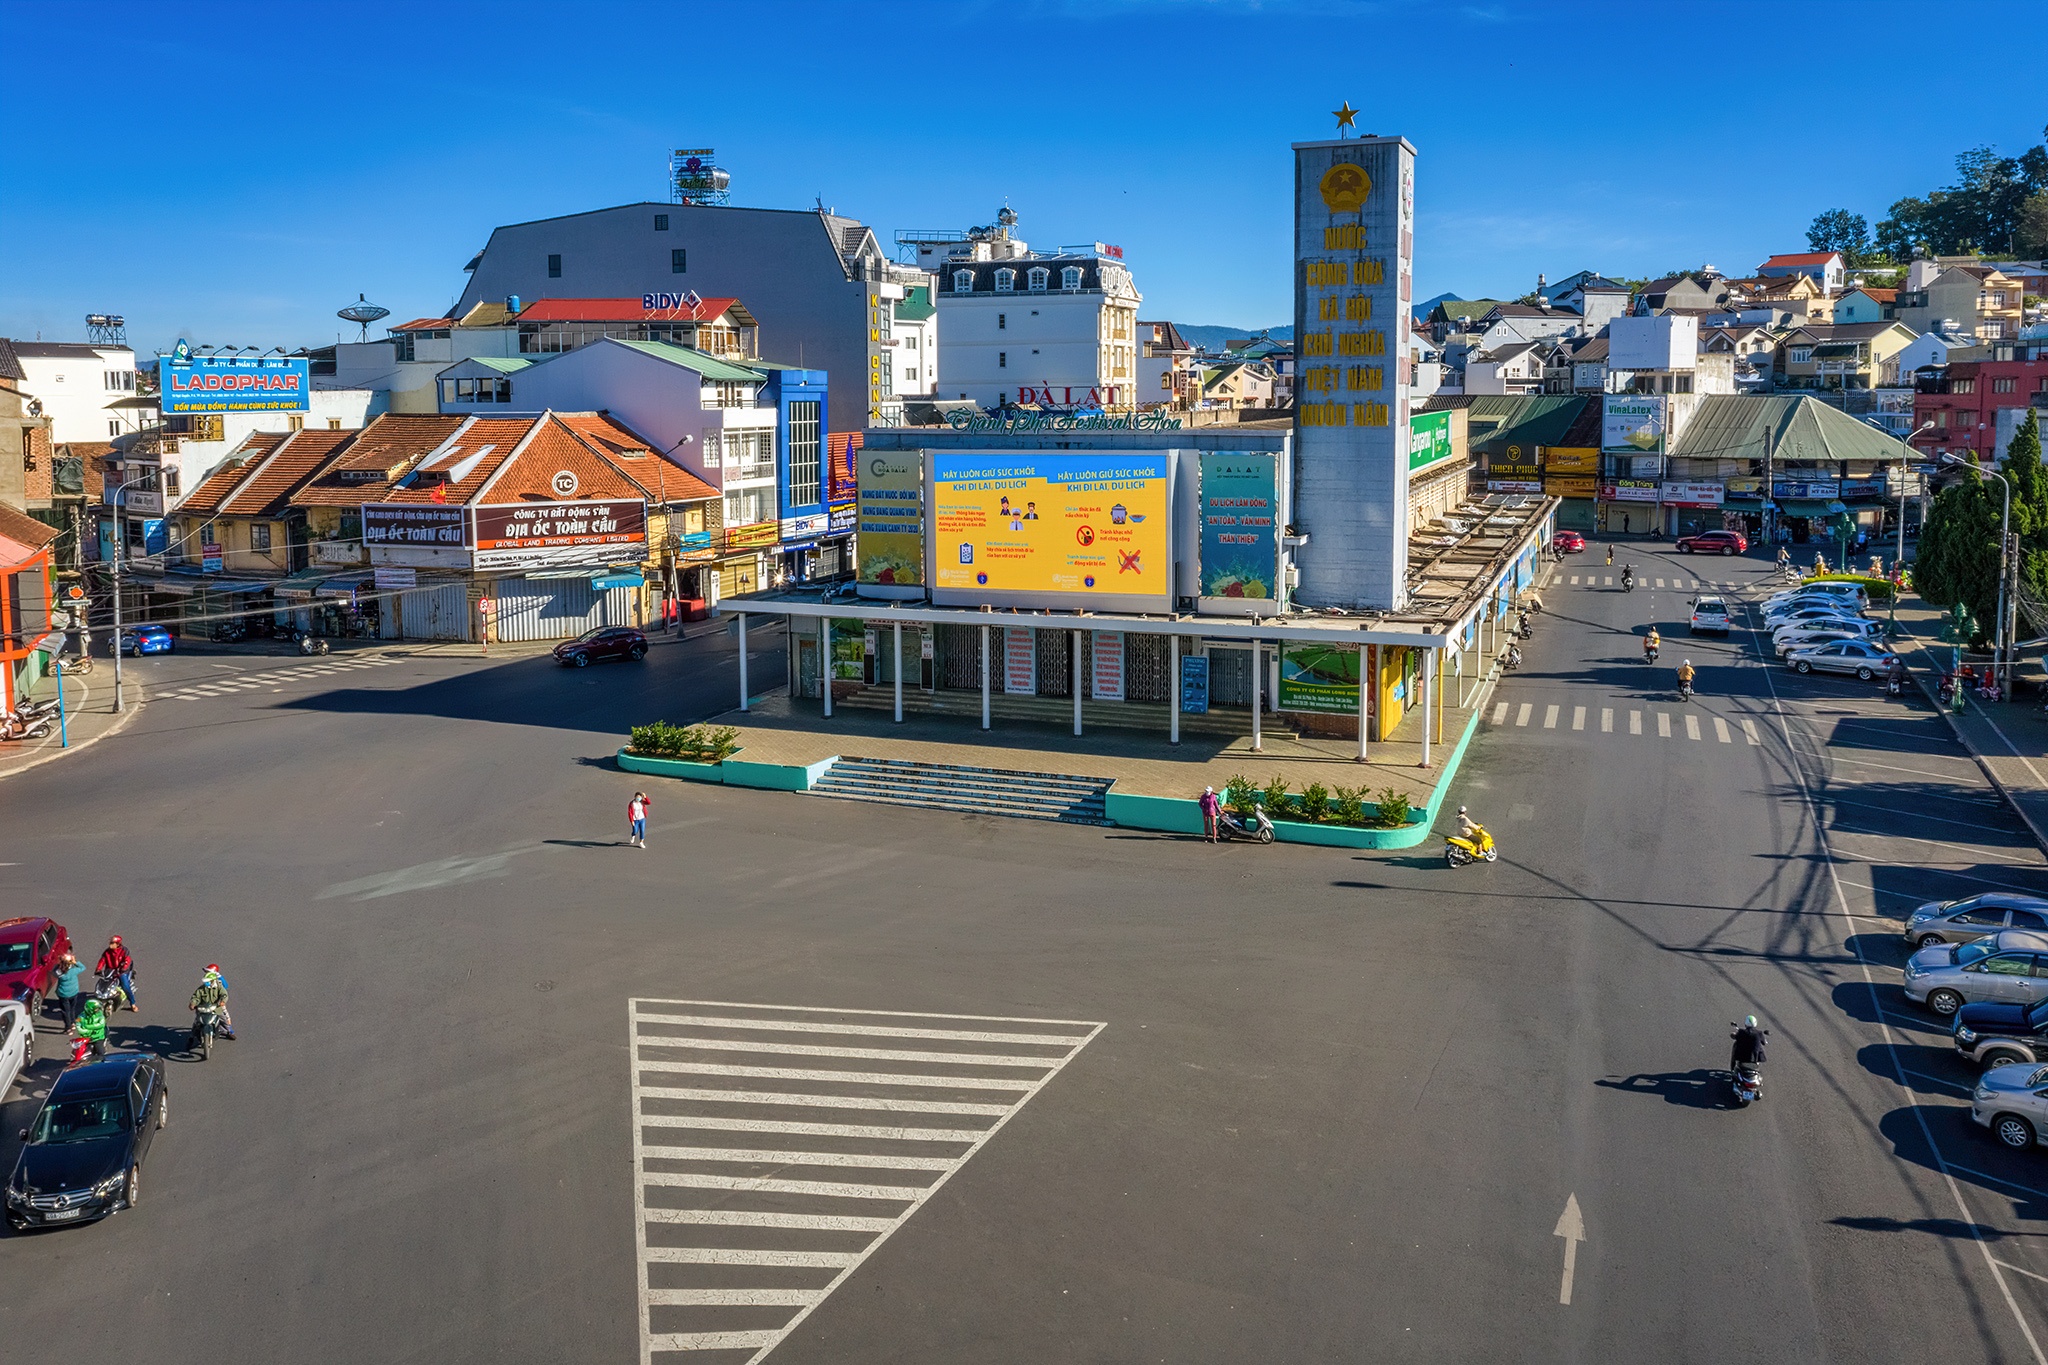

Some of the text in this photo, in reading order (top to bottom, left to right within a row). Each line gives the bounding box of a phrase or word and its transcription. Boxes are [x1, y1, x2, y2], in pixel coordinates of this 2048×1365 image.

[1324, 222, 1367, 250] NƯỚC
[1307, 260, 1347, 290] CỘNG
[642, 293, 684, 310] BIDV
[1319, 293, 1371, 325] XÃ HỘI
[871, 294, 879, 341] KIM
[1303, 326, 1385, 356] CHỦ NGHĨA
[172, 374, 299, 390] LADOPHAR
[1306, 366, 1382, 396] VIỆT NAM
[1017, 381, 1121, 410] ĐÀ LẠT
[174, 402, 189, 410] BỐN
[191, 402, 206, 410] MÙA
[208, 402, 226, 410] ĐỒNG
[229, 402, 246, 410] HÀNH
[249, 402, 266, 410] CÙNG
[267, 401, 279, 409] SỨC
[1301, 400, 1388, 426] MUÔN NĂM
[1608, 405, 1651, 414] VinaLatex
[946, 407, 1183, 437] Thành Phố Festival Hoa
[943, 466, 1035, 478] HÃY LUÔN GIỮ SỨC KHỎE
[1058, 467, 1155, 480] HÃY LUÔN GIỮ SỨC KHỎE
[557, 479, 573, 488] TC
[979, 482, 993, 491] LẠI,
[1008, 480, 1026, 490] LỊCH
[1094, 483, 1109, 492] LẠI,
[1126, 481, 1144, 490] LỊCH
[1784, 486, 1804, 496] Tiger
[1210, 495, 1267, 509] DU LỊCH LÂM ĐỒNG
[514, 507, 590, 519] CÔNG TY BẤT ĐỘNG
[1220, 513, 1236, 525] TOÀN
[1240, 514, 1253, 525] VĂN
[1255, 517, 1271, 526] MINH
[368, 523, 460, 542] ĐỊA ỐC TOÀN CẦU
[506, 516, 617, 539] ĐỊA ỐC TOÀN CẦU
[796, 520, 808, 530] BIDV
[1218, 532, 1235, 544] THÂN
